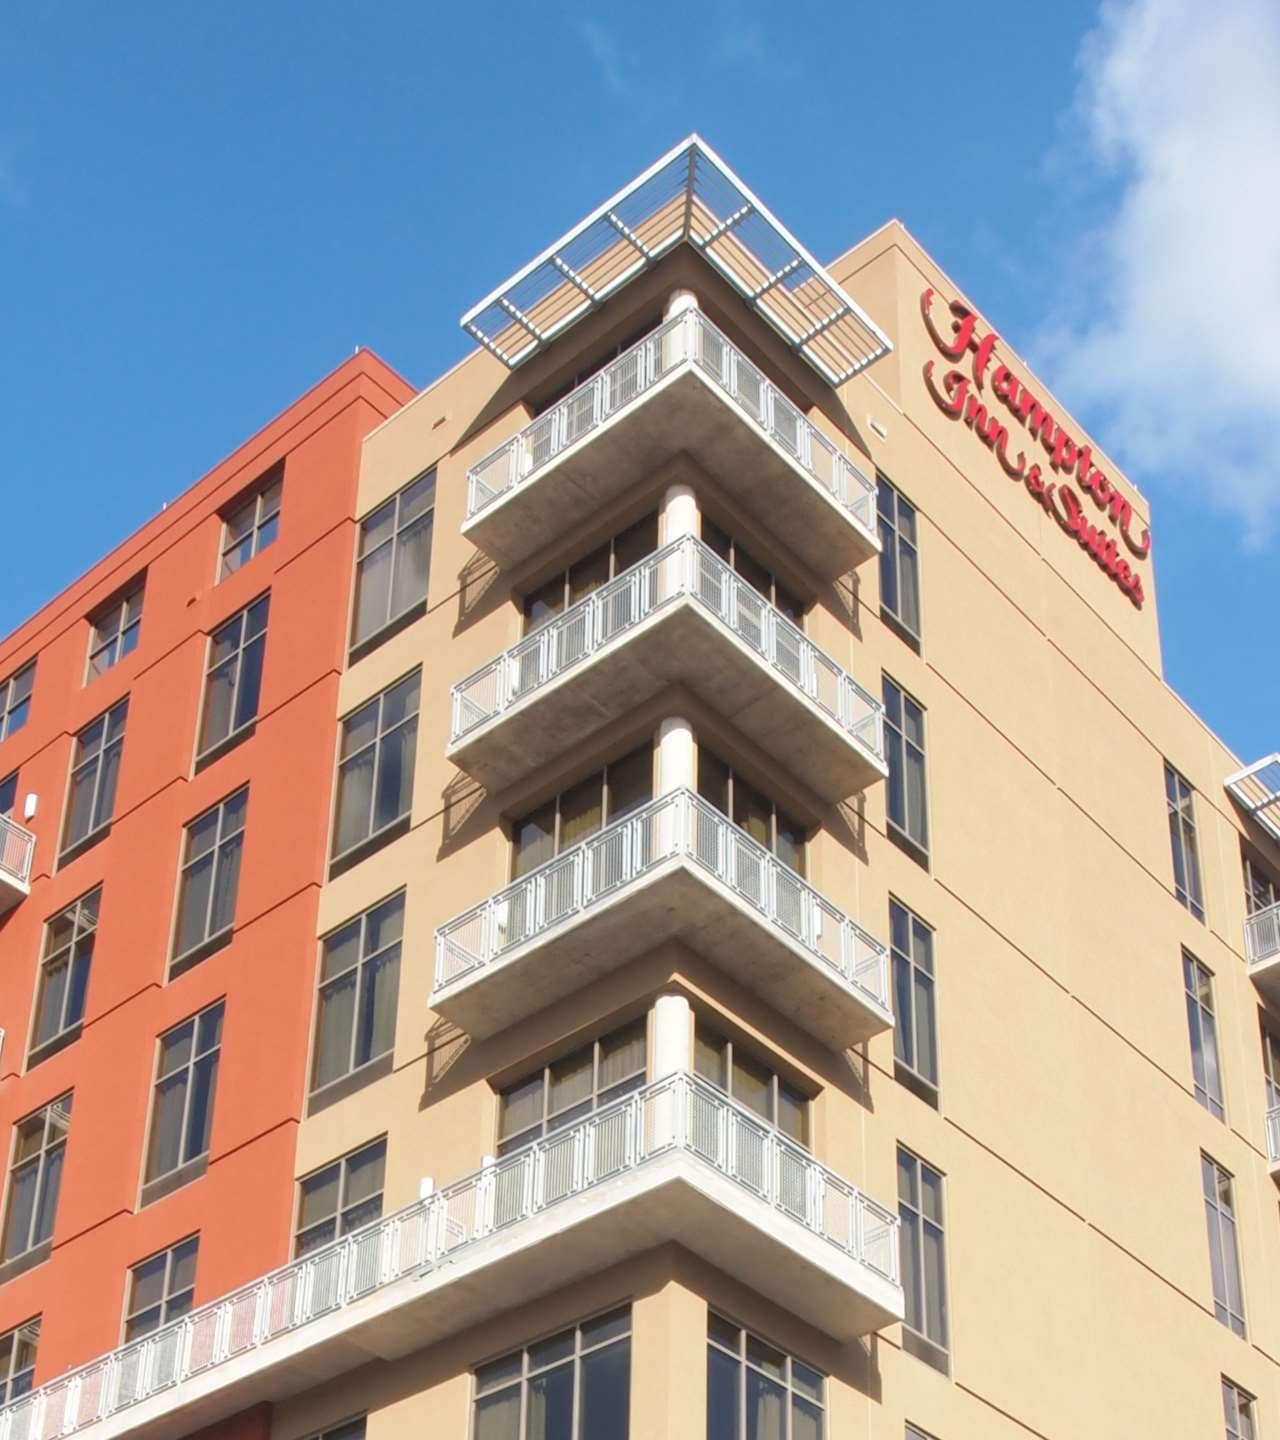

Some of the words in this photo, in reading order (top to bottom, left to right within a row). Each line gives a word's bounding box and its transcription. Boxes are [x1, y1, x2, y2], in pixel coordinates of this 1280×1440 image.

[920, 287, 1151, 560] Hampton
[923, 359, 1026, 482] Inn
[1042, 483, 1144, 611] Suites
